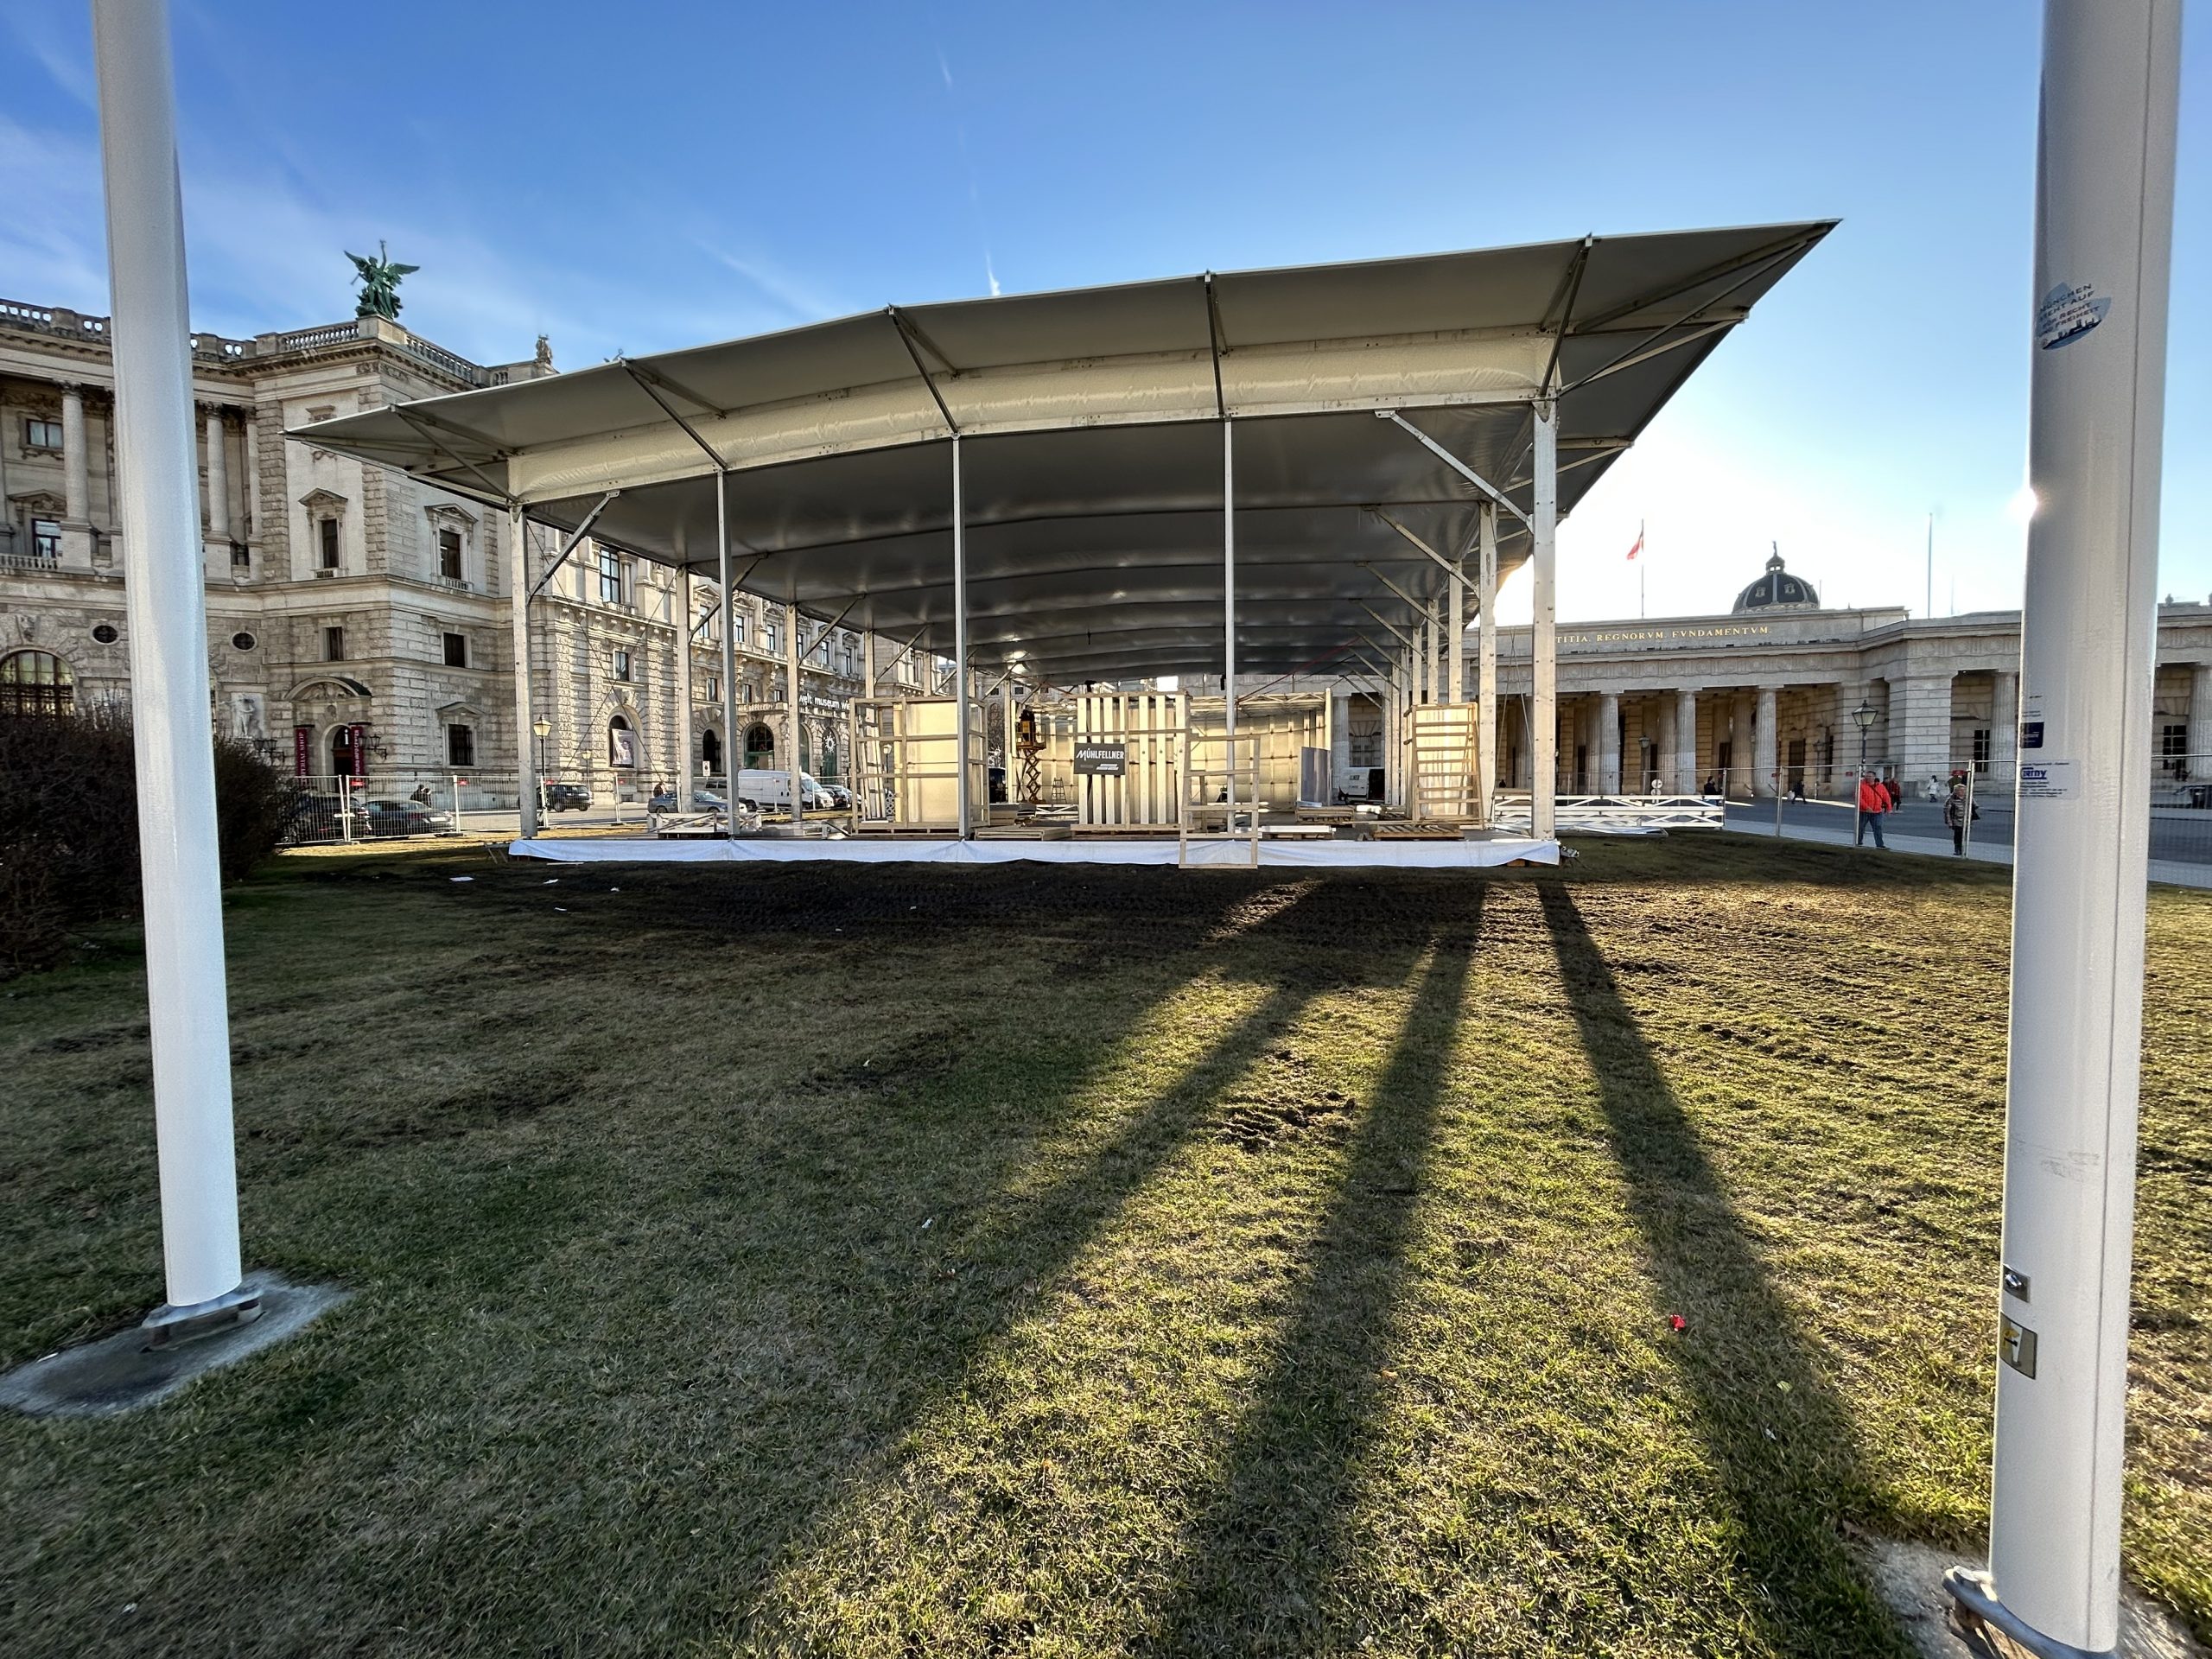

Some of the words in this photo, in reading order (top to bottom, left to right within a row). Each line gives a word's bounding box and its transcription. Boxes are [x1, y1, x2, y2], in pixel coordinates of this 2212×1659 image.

[2070, 289, 2095, 304] AUF
[2059, 302, 2092, 319] RECHT
[1076, 747, 1124, 761] MÜHLFELLNER
